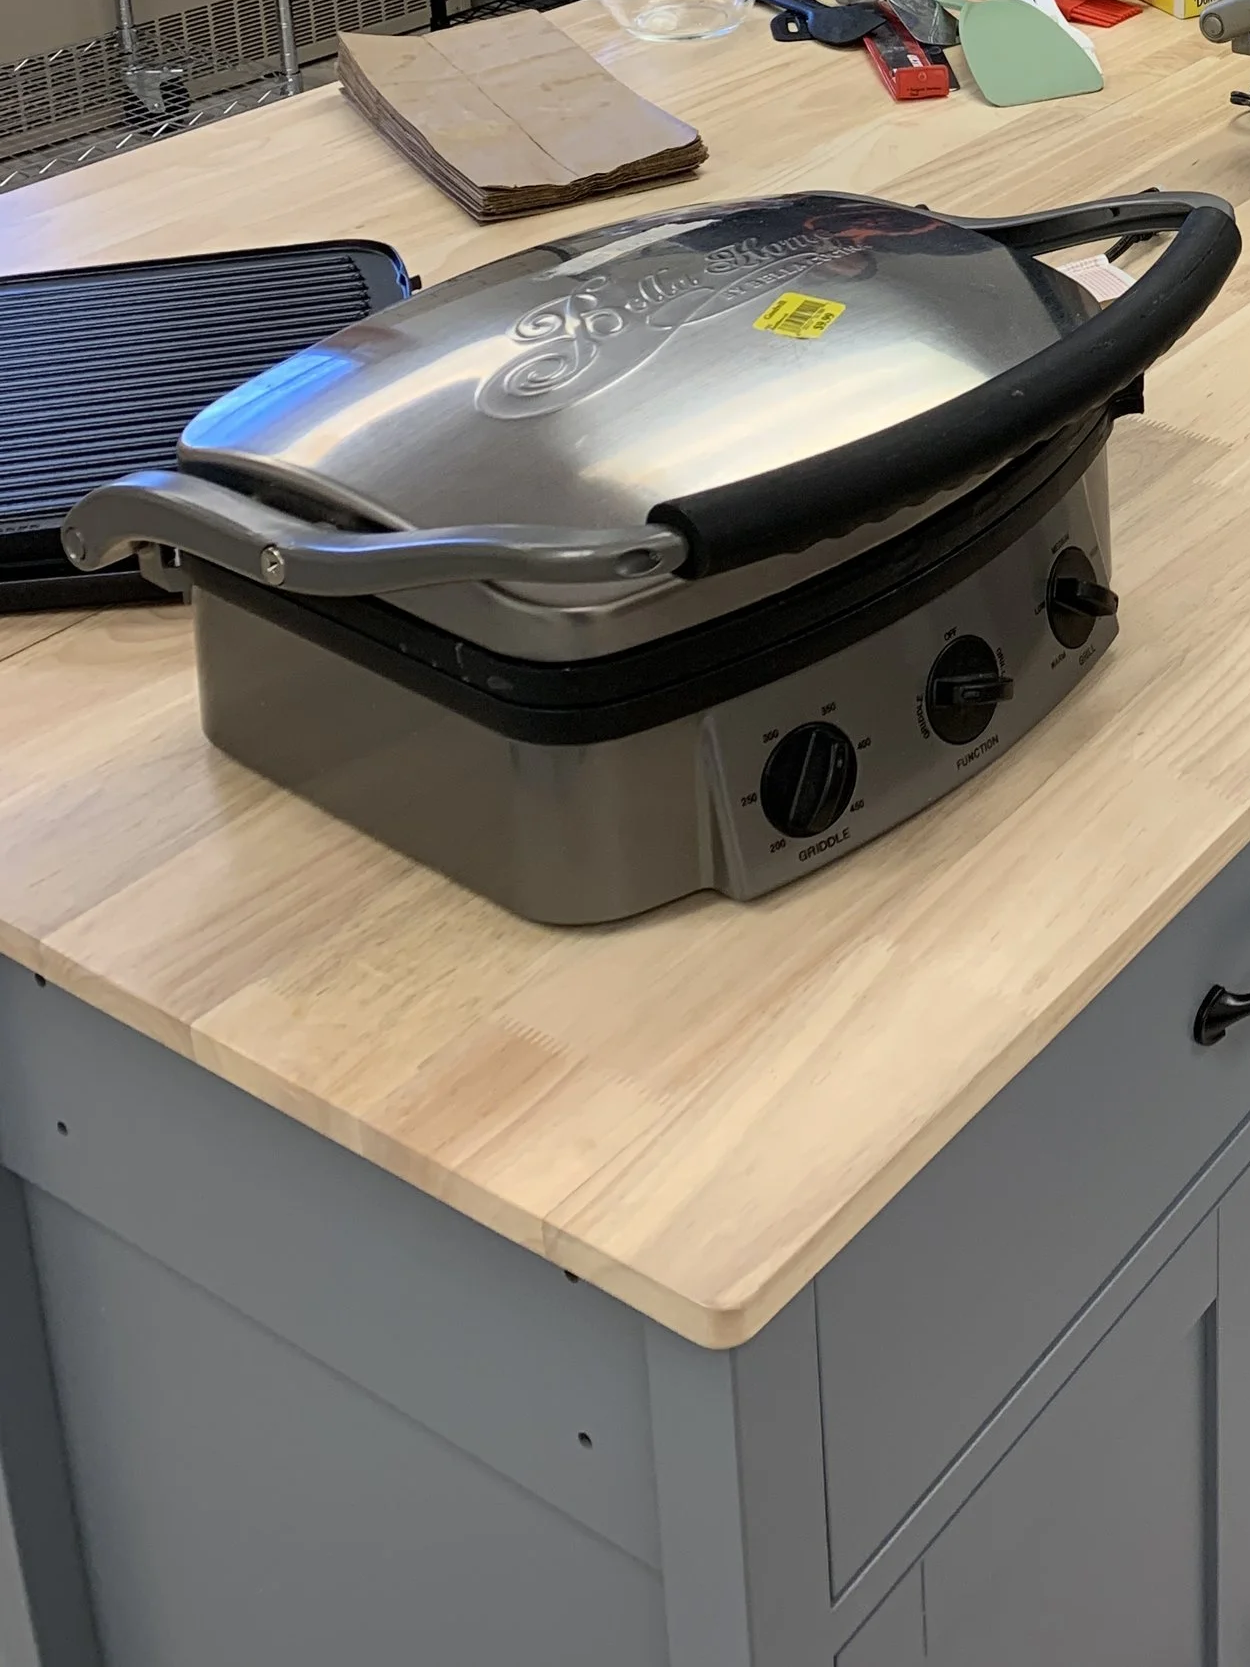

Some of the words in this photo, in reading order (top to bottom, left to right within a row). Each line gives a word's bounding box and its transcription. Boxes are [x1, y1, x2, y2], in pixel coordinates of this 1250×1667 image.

[752, 260, 806, 289] BELLA
[943, 625, 958, 642] OFF
[821, 701, 837, 717] 350
[955, 734, 1000, 771] FUNCTION
[740, 791, 758, 808] 250
[769, 838, 787, 854] 200
[798, 826, 851, 863] GRIDDLE
